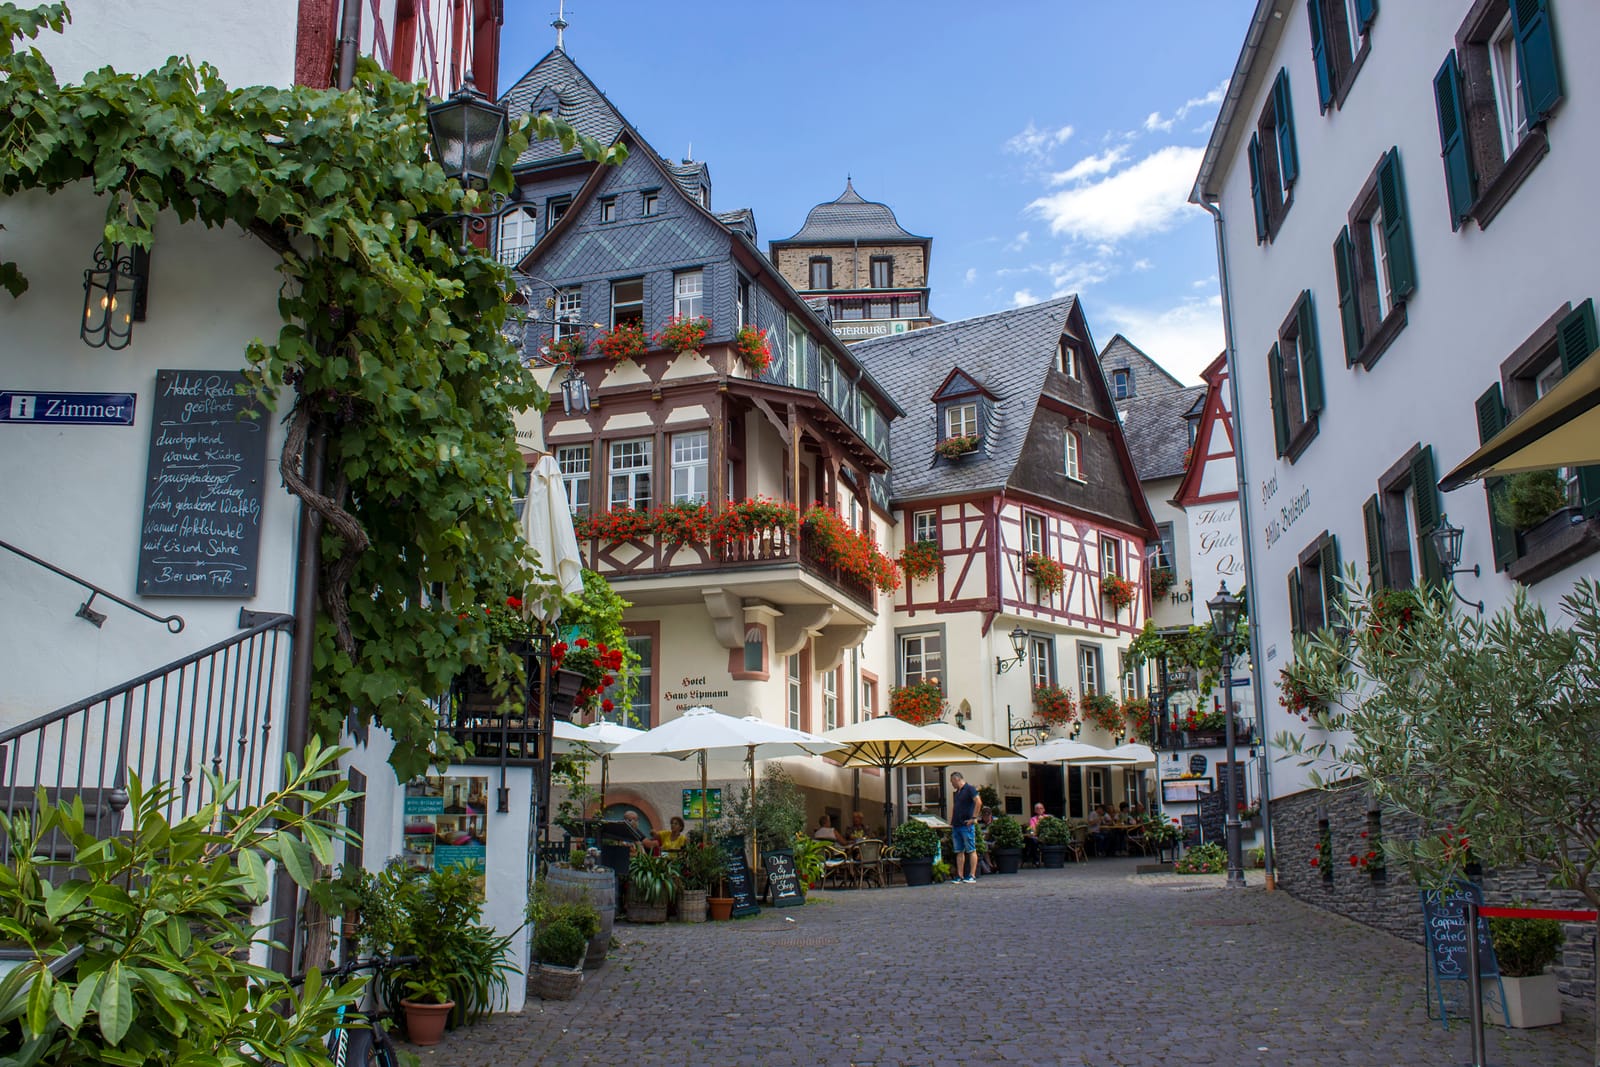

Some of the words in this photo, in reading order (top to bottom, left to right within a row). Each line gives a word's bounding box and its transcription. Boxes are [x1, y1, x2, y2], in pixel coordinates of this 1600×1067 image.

[45, 399, 124, 418] Zimmer
[156, 428, 225, 450] durchgehend
[162, 450, 201, 463] warme
[204, 448, 245, 463] Küche
[219, 497, 261, 525] Waffeln
[1196, 507, 1235, 526] Hotel
[143, 536, 164, 551] mit
[182, 540, 203, 553] und
[205, 538, 241, 557] Sahne
[1198, 529, 1239, 556] Gute
[155, 566, 183, 583] Bier
[185, 573, 207, 582] vom
[681, 676, 706, 687] Hotel
[664, 691, 688, 701] Haus
[689, 689, 729, 701] Lipmann
